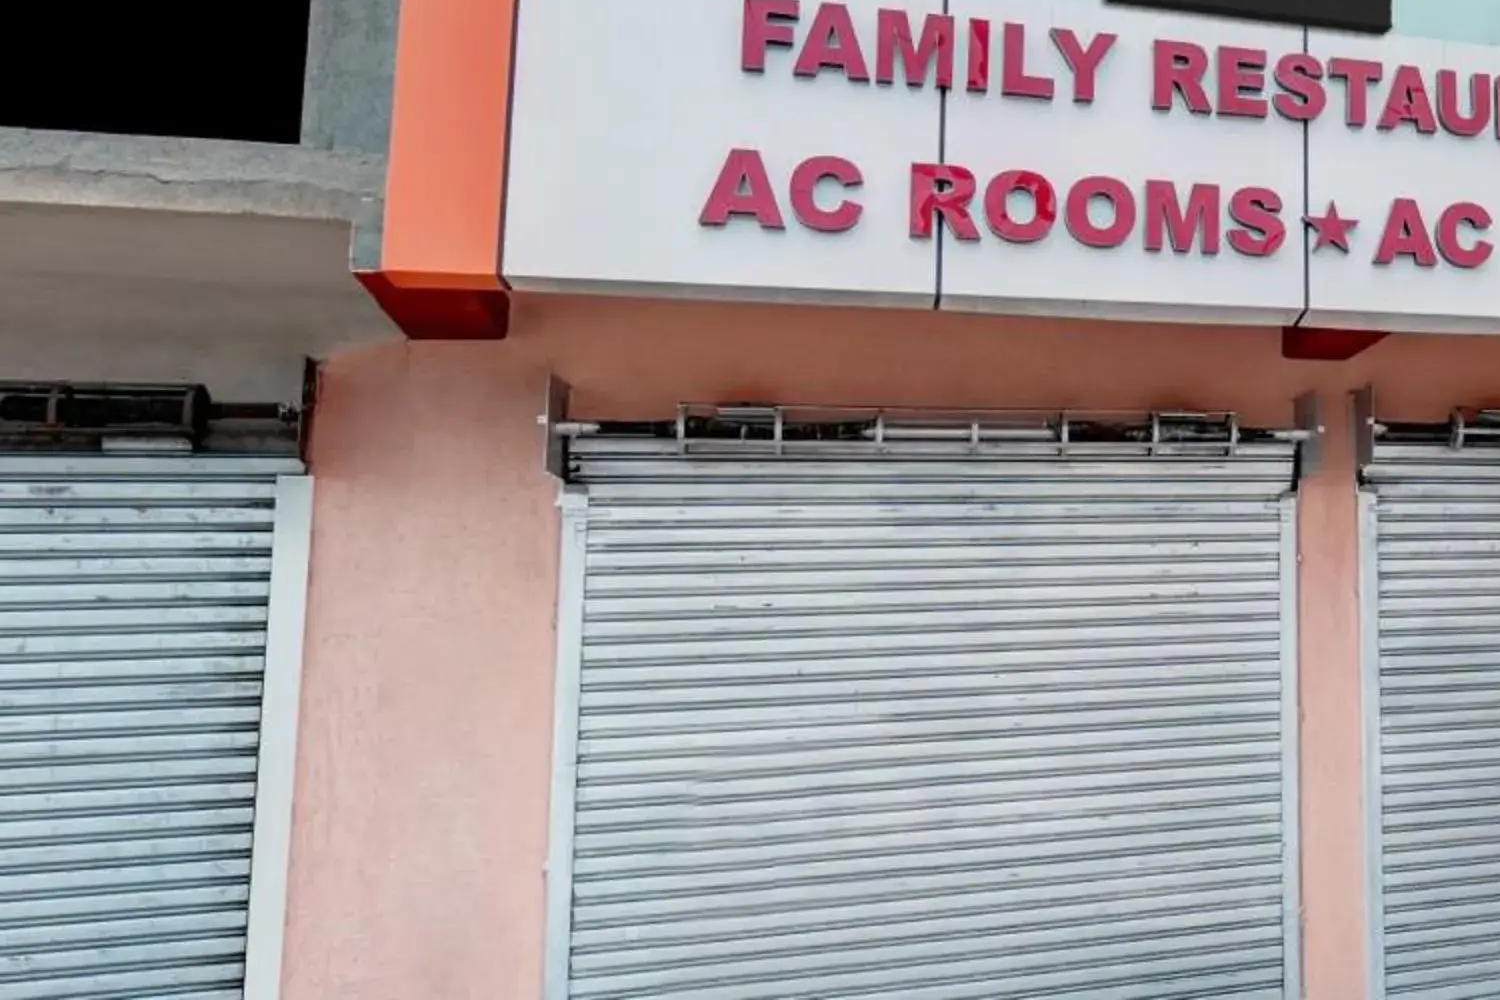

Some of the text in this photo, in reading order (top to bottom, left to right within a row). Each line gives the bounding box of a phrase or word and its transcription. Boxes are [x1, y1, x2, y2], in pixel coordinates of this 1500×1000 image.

[699, 148, 863, 232] AC
[909, 162, 1287, 257] ROOMS
[1374, 197, 1493, 268] AC
